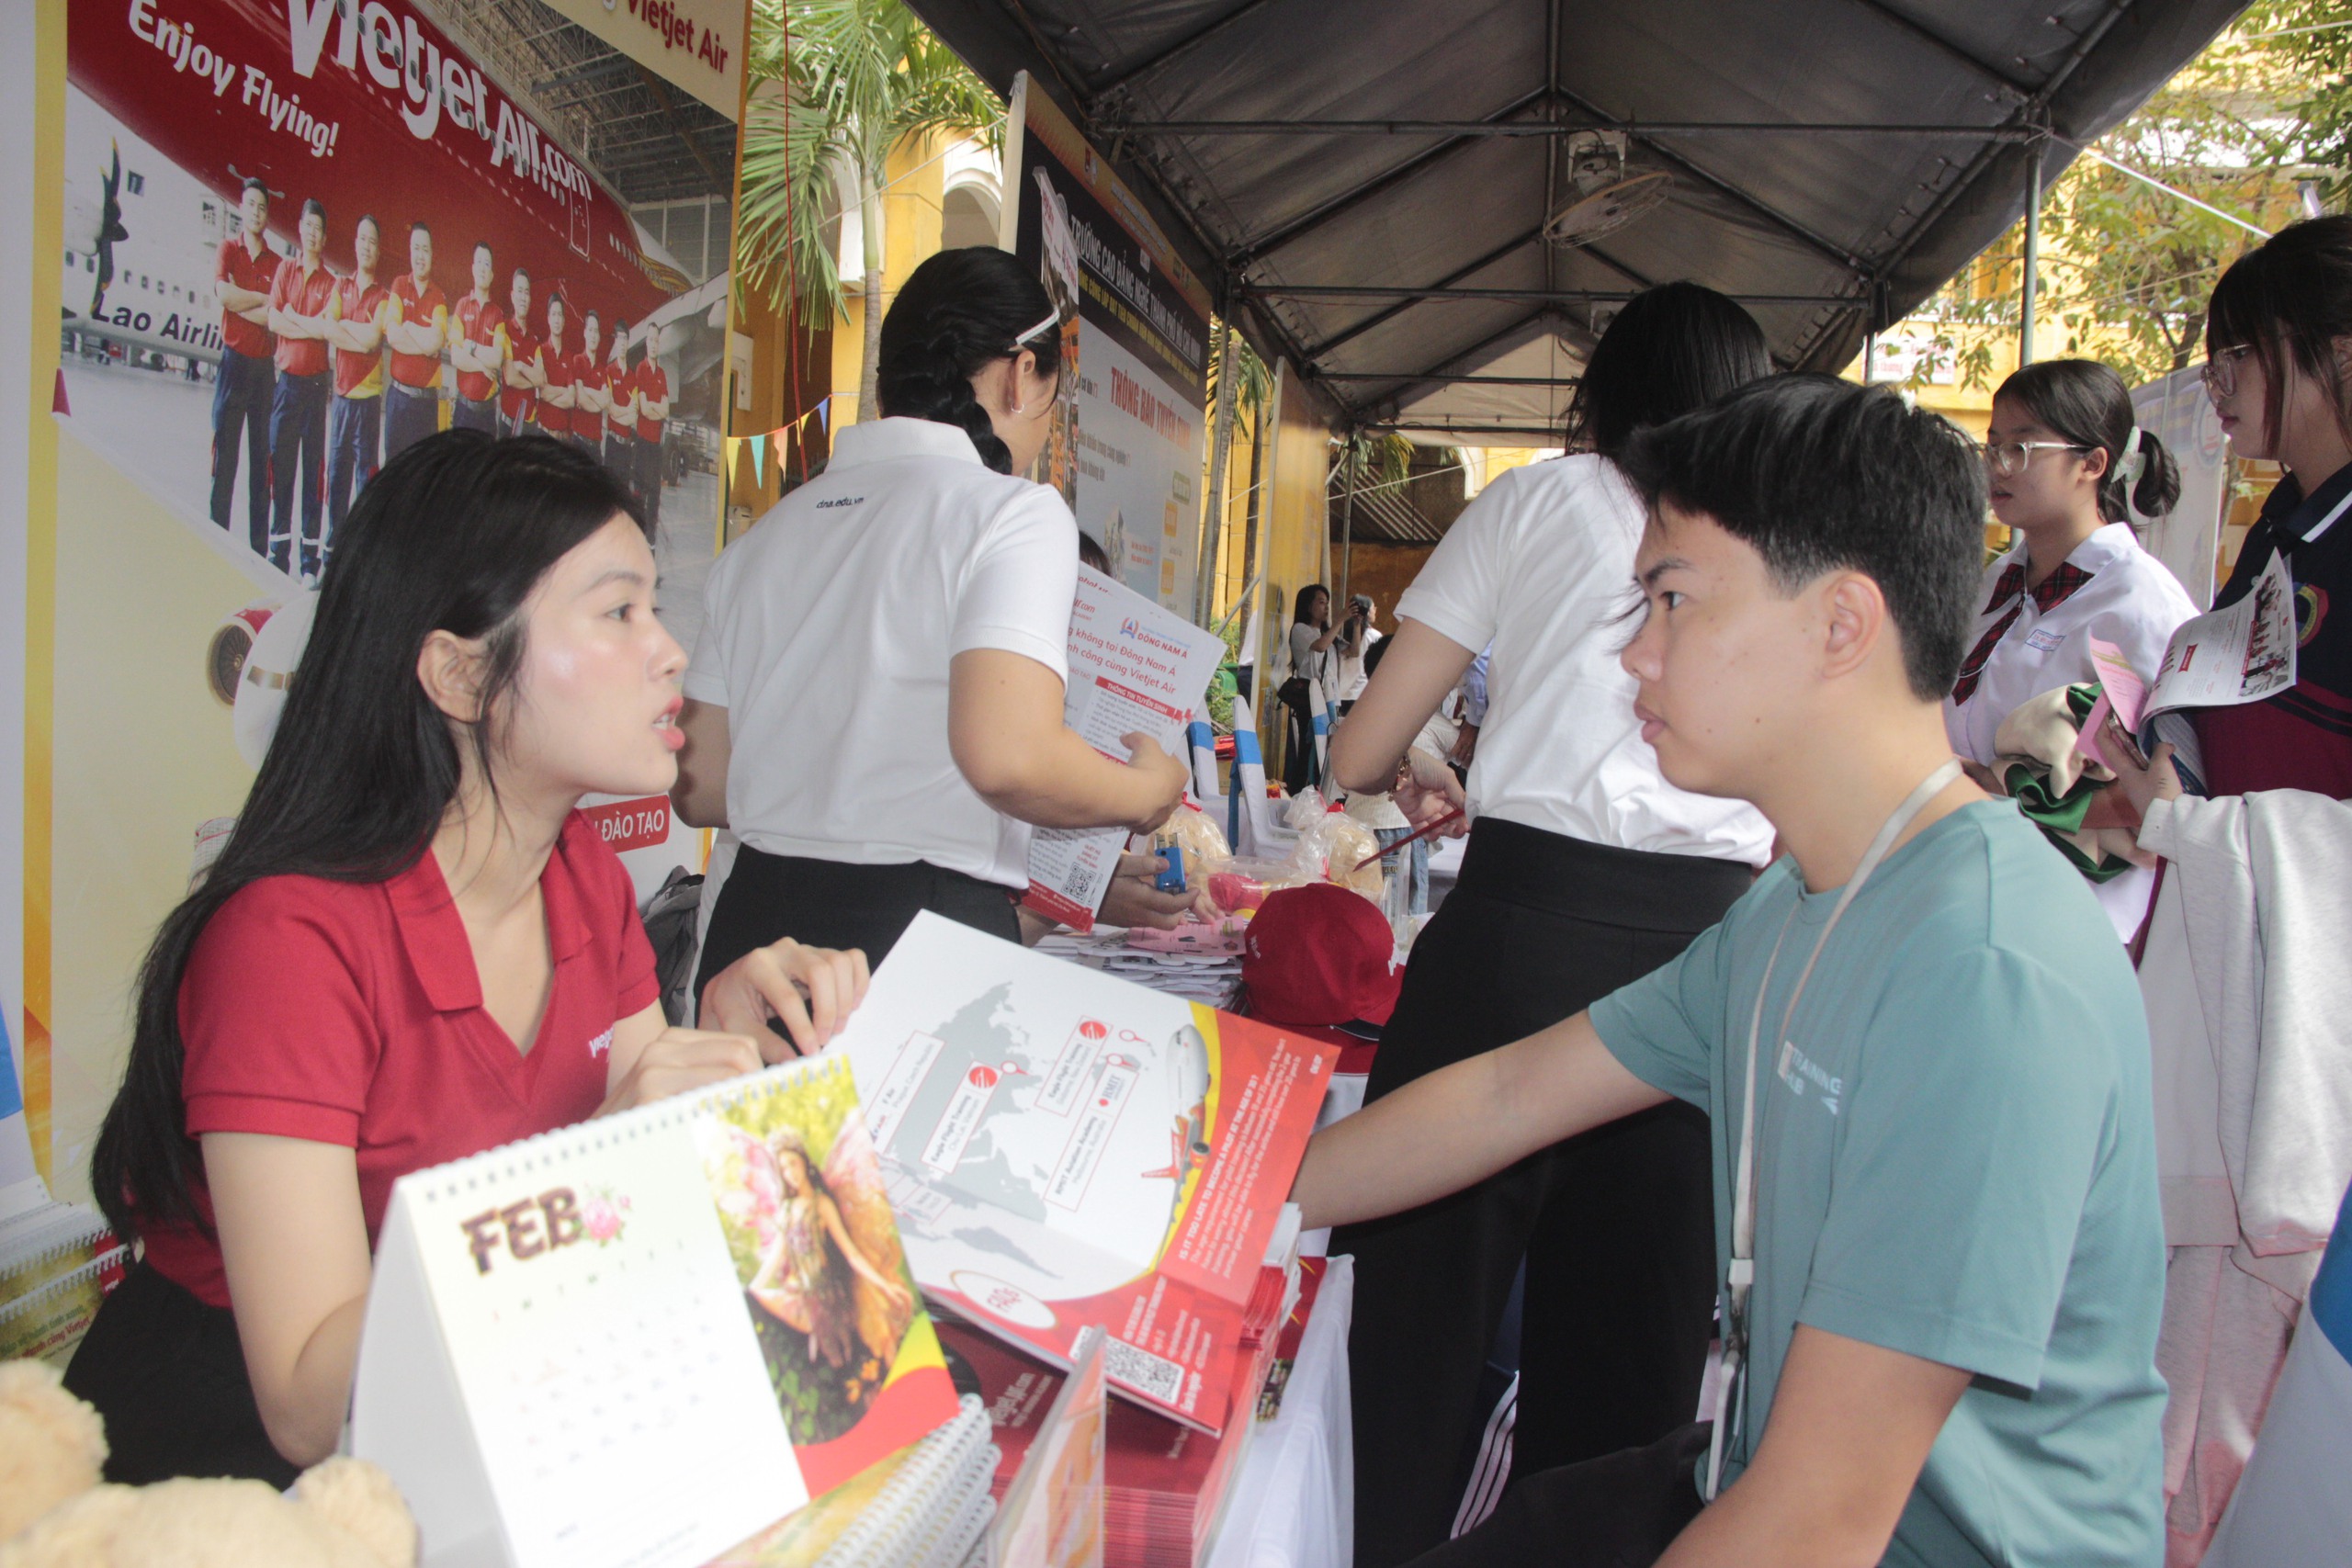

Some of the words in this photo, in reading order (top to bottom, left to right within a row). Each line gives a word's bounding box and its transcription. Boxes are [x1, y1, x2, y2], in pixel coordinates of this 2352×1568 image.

[697, 28, 729, 73] Air
[129, 0, 235, 97] Enjoy
[242, 63, 339, 158] Flying!
[1070, 213, 1101, 269] TRƯỜNG
[1102, 245, 1115, 281] CAO
[1116, 249, 1134, 299] ĐẲNG
[92, 306, 152, 332] Lao
[160, 312, 223, 351] Airli
[1111, 367, 1139, 418] THÔNG
[1140, 387, 1155, 429] BÁO
[1157, 399, 1176, 443] TUYỂN
[1075, 628, 1103, 648] không
[1106, 640, 1117, 653] tại
[1119, 646, 1144, 665] Đông
[1145, 657, 1167, 672] Nam
[1168, 664, 1176, 676] Á
[1137, 631, 1160, 649] ĐÔNG
[1161, 642, 1181, 657] NAM
[1182, 648, 1188, 660] Á
[1080, 649, 1103, 666] công
[1104, 658, 1127, 676] cùng
[1130, 668, 1159, 688] Vietjet
[1160, 681, 1177, 694] Air
[1107, 682, 1127, 697] THÔNG
[1126, 690, 1136, 701] TIN
[1136, 694, 1154, 708] TUYỂN
[1153, 701, 1169, 714] SINH
[601, 810, 634, 841] ĐÀO
[637, 808, 664, 840] TẠO
[1048, 1081, 1061, 1099] Eagle
[1057, 1065, 1069, 1081] Flight
[1067, 1043, 1081, 1064] Training
[1792, 1047, 1842, 1095] TRAINING
[1102, 1074, 1120, 1098] RMIT
[1244, 1088, 1253, 1098] OF
[1234, 1109, 1244, 1123] THE
[1238, 1096, 1250, 1110] AGE
[932, 1142, 945, 1162] Eagle
[942, 1121, 956, 1141] Flight
[953, 1094, 970, 1120] Training
[1221, 1132, 1234, 1151] PILOT
[1229, 1122, 1238, 1133] AT
[1056, 1175, 1069, 1194] RMIT
[1065, 1145, 1080, 1172] Aviation
[1080, 1116, 1096, 1144] Academy
[1218, 1151, 1227, 1159] A
[1207, 1159, 1224, 1189] BECOME
[1202, 1188, 1212, 1201] TO
[1194, 1201, 1207, 1221] LATE
[459, 1186, 582, 1277] FEB
[1182, 1238, 1192, 1248] IT
[1187, 1221, 1199, 1238] TOO
[1179, 1247, 1188, 1259] IS
[1191, 1248, 1201, 1263] The
[988, 1287, 1023, 1313] FAQs
